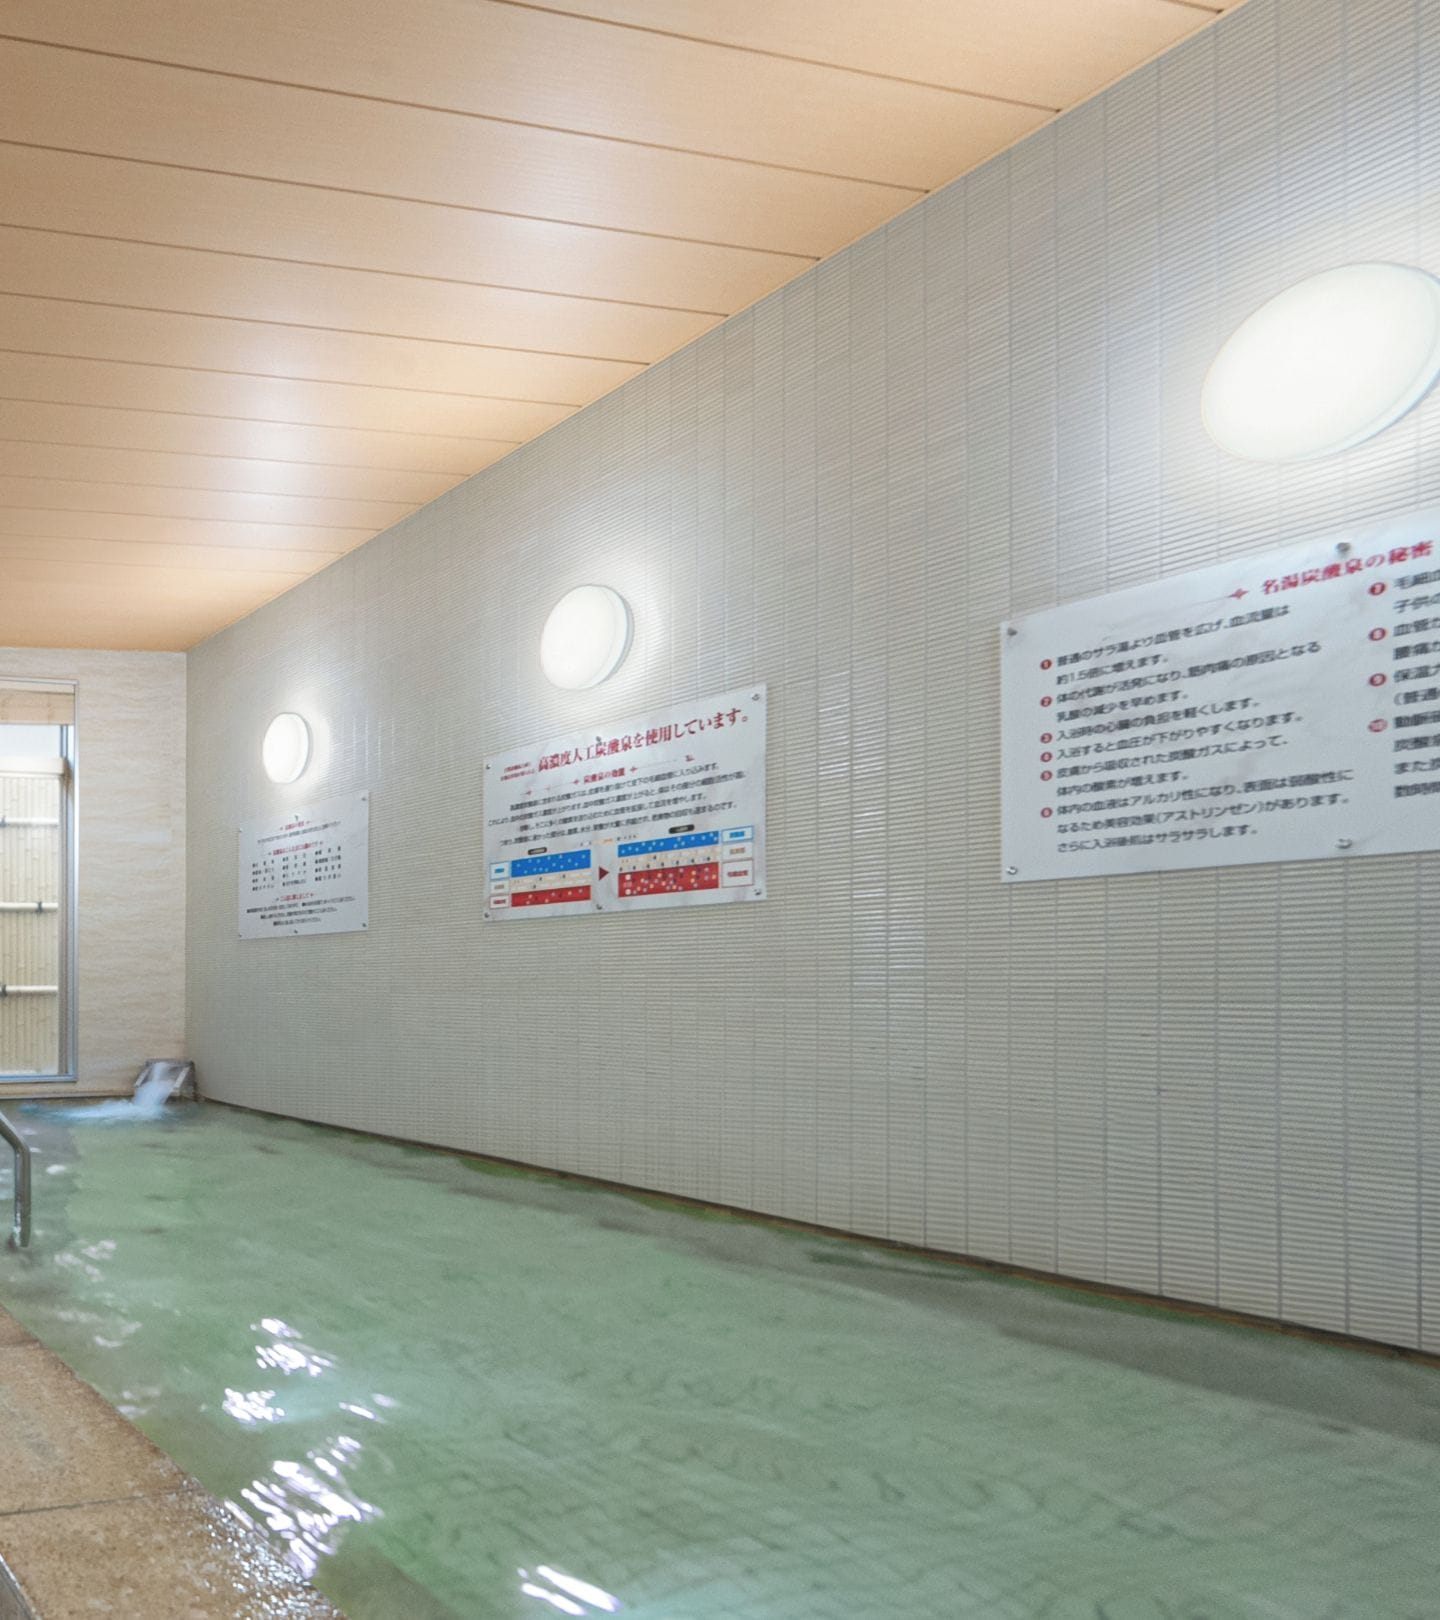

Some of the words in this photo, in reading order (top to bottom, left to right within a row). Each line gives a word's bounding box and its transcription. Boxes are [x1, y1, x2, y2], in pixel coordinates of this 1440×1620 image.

[1262, 540, 1434, 595] 名湯炭酸泉の秘密
